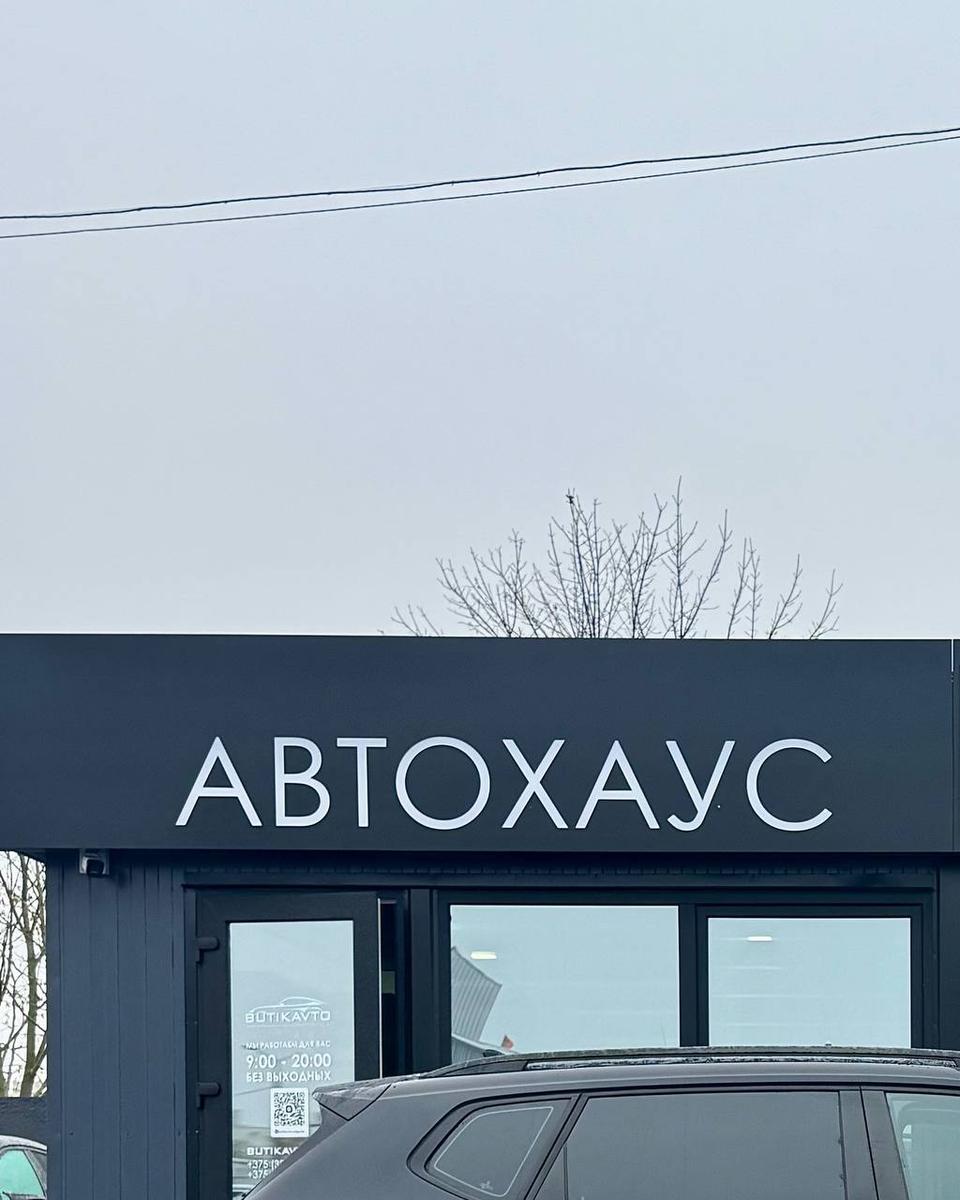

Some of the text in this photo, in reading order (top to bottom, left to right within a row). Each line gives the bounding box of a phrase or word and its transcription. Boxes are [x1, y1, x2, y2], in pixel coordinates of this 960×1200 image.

[175, 736, 834, 832] АВТОХАУС
[245, 1010, 331, 1023] BUTIKAVTO
[246, 1054, 277, 1069] 9:00
[291, 1053, 332, 1068] 20:00
[246, 1070, 332, 1083] БЕЗ ВЫХОДНЫХ
[247, 1146, 299, 1156] BUTIKAV
